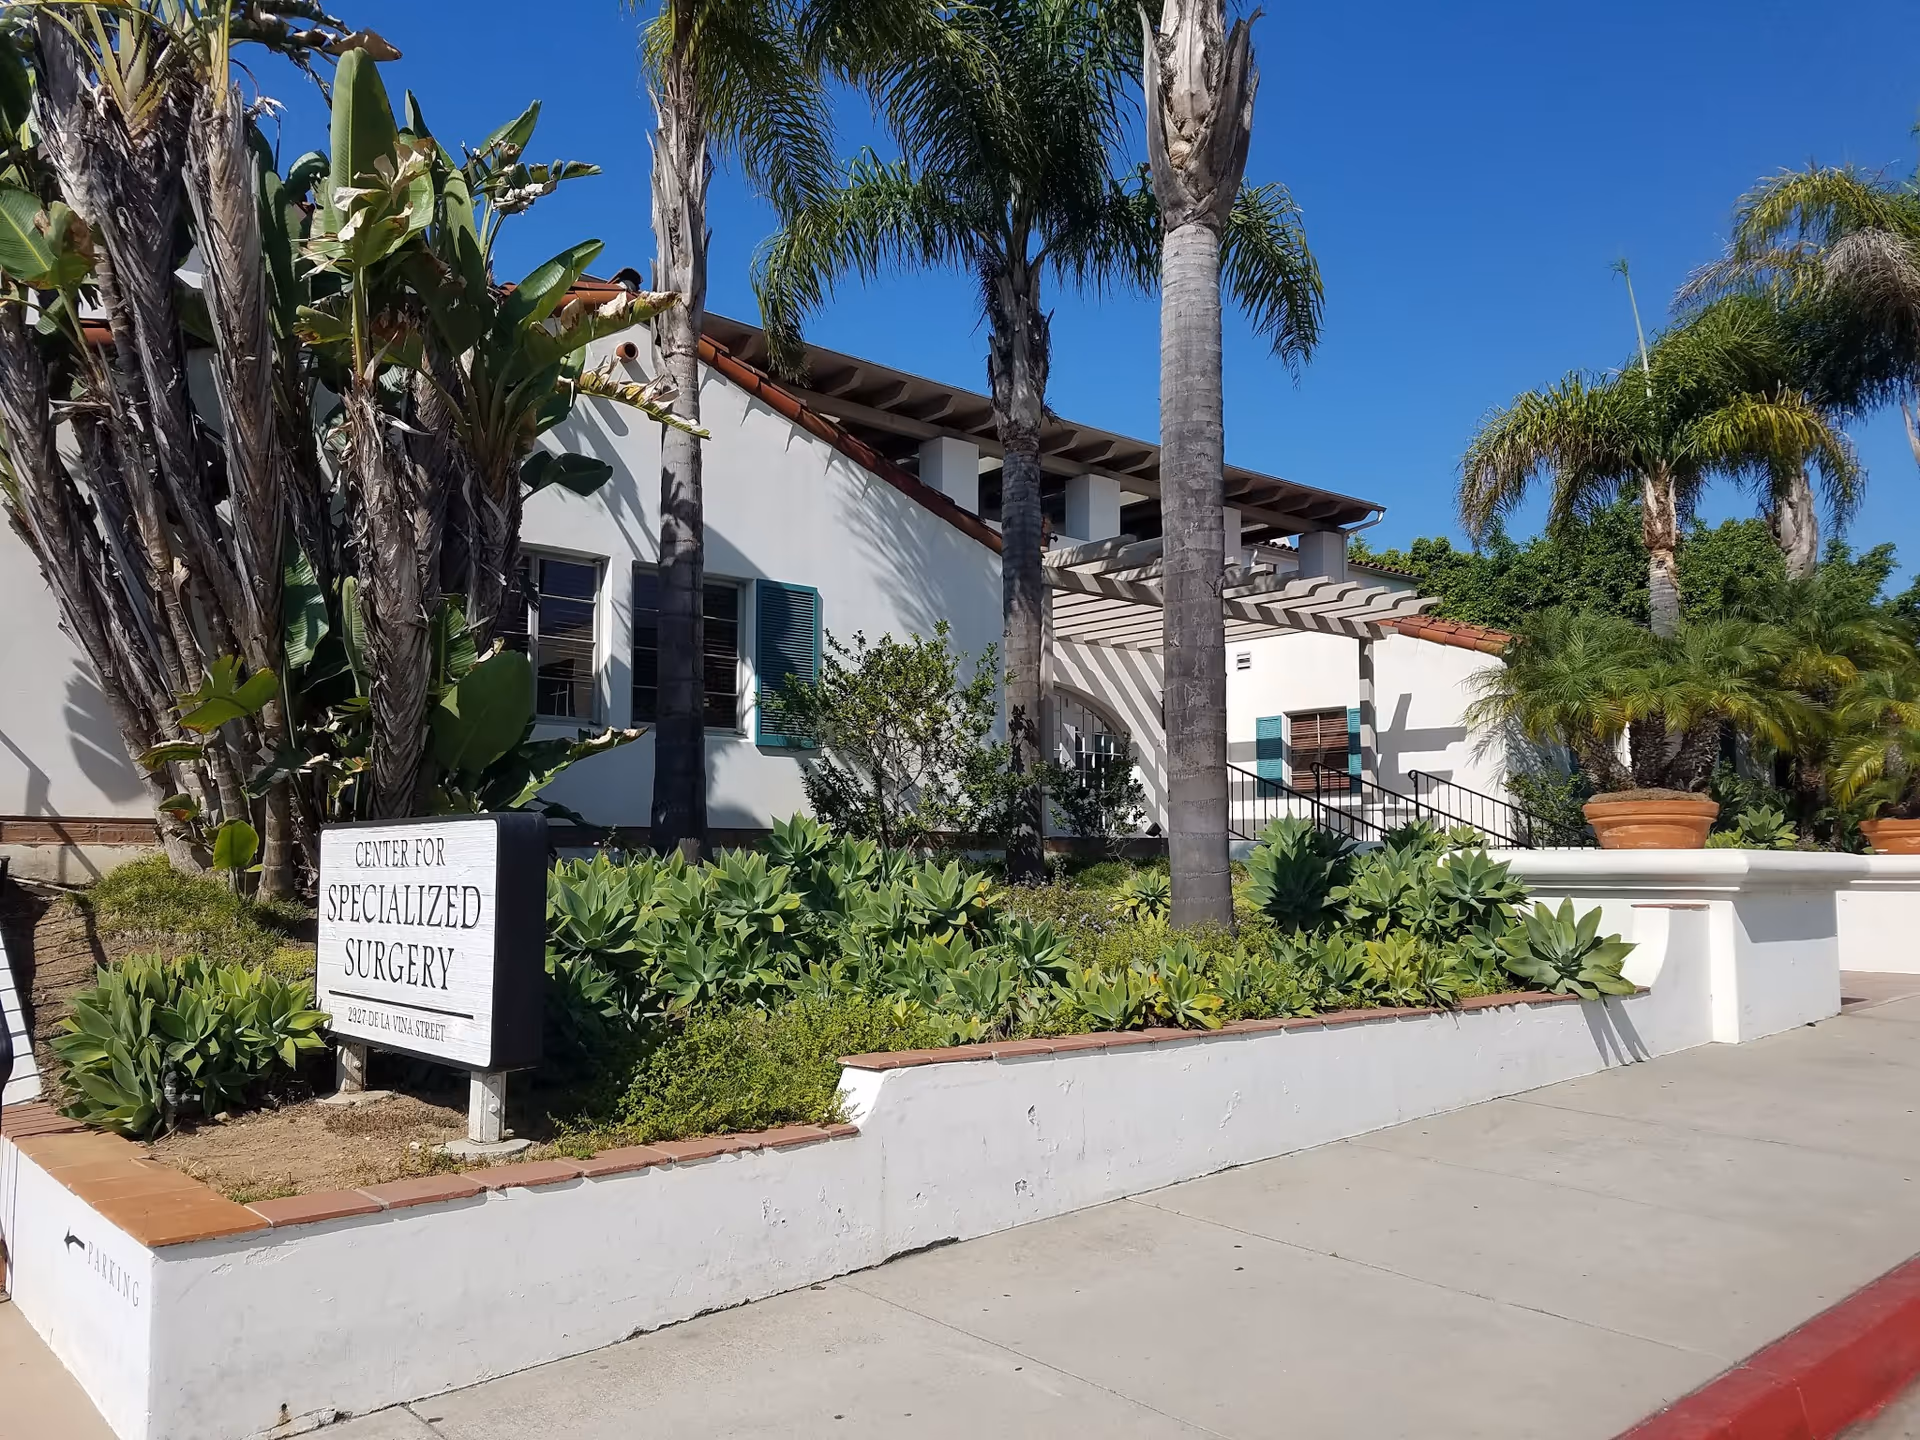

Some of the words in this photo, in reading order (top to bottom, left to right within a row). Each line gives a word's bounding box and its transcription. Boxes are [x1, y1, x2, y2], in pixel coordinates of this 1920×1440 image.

[355, 840, 409, 868] CENTER
[415, 837, 446, 867] FOR
[327, 884, 482, 929] SPECIALIZED
[344, 937, 455, 990] SURGERY
[347, 1006, 367, 1026] 2927
[368, 1010, 379, 1028] DE
[381, 1012, 390, 1031] LA
[392, 1014, 414, 1036] VINA
[415, 1019, 446, 1042] STREET
[87, 1240, 140, 1307] PARKING
